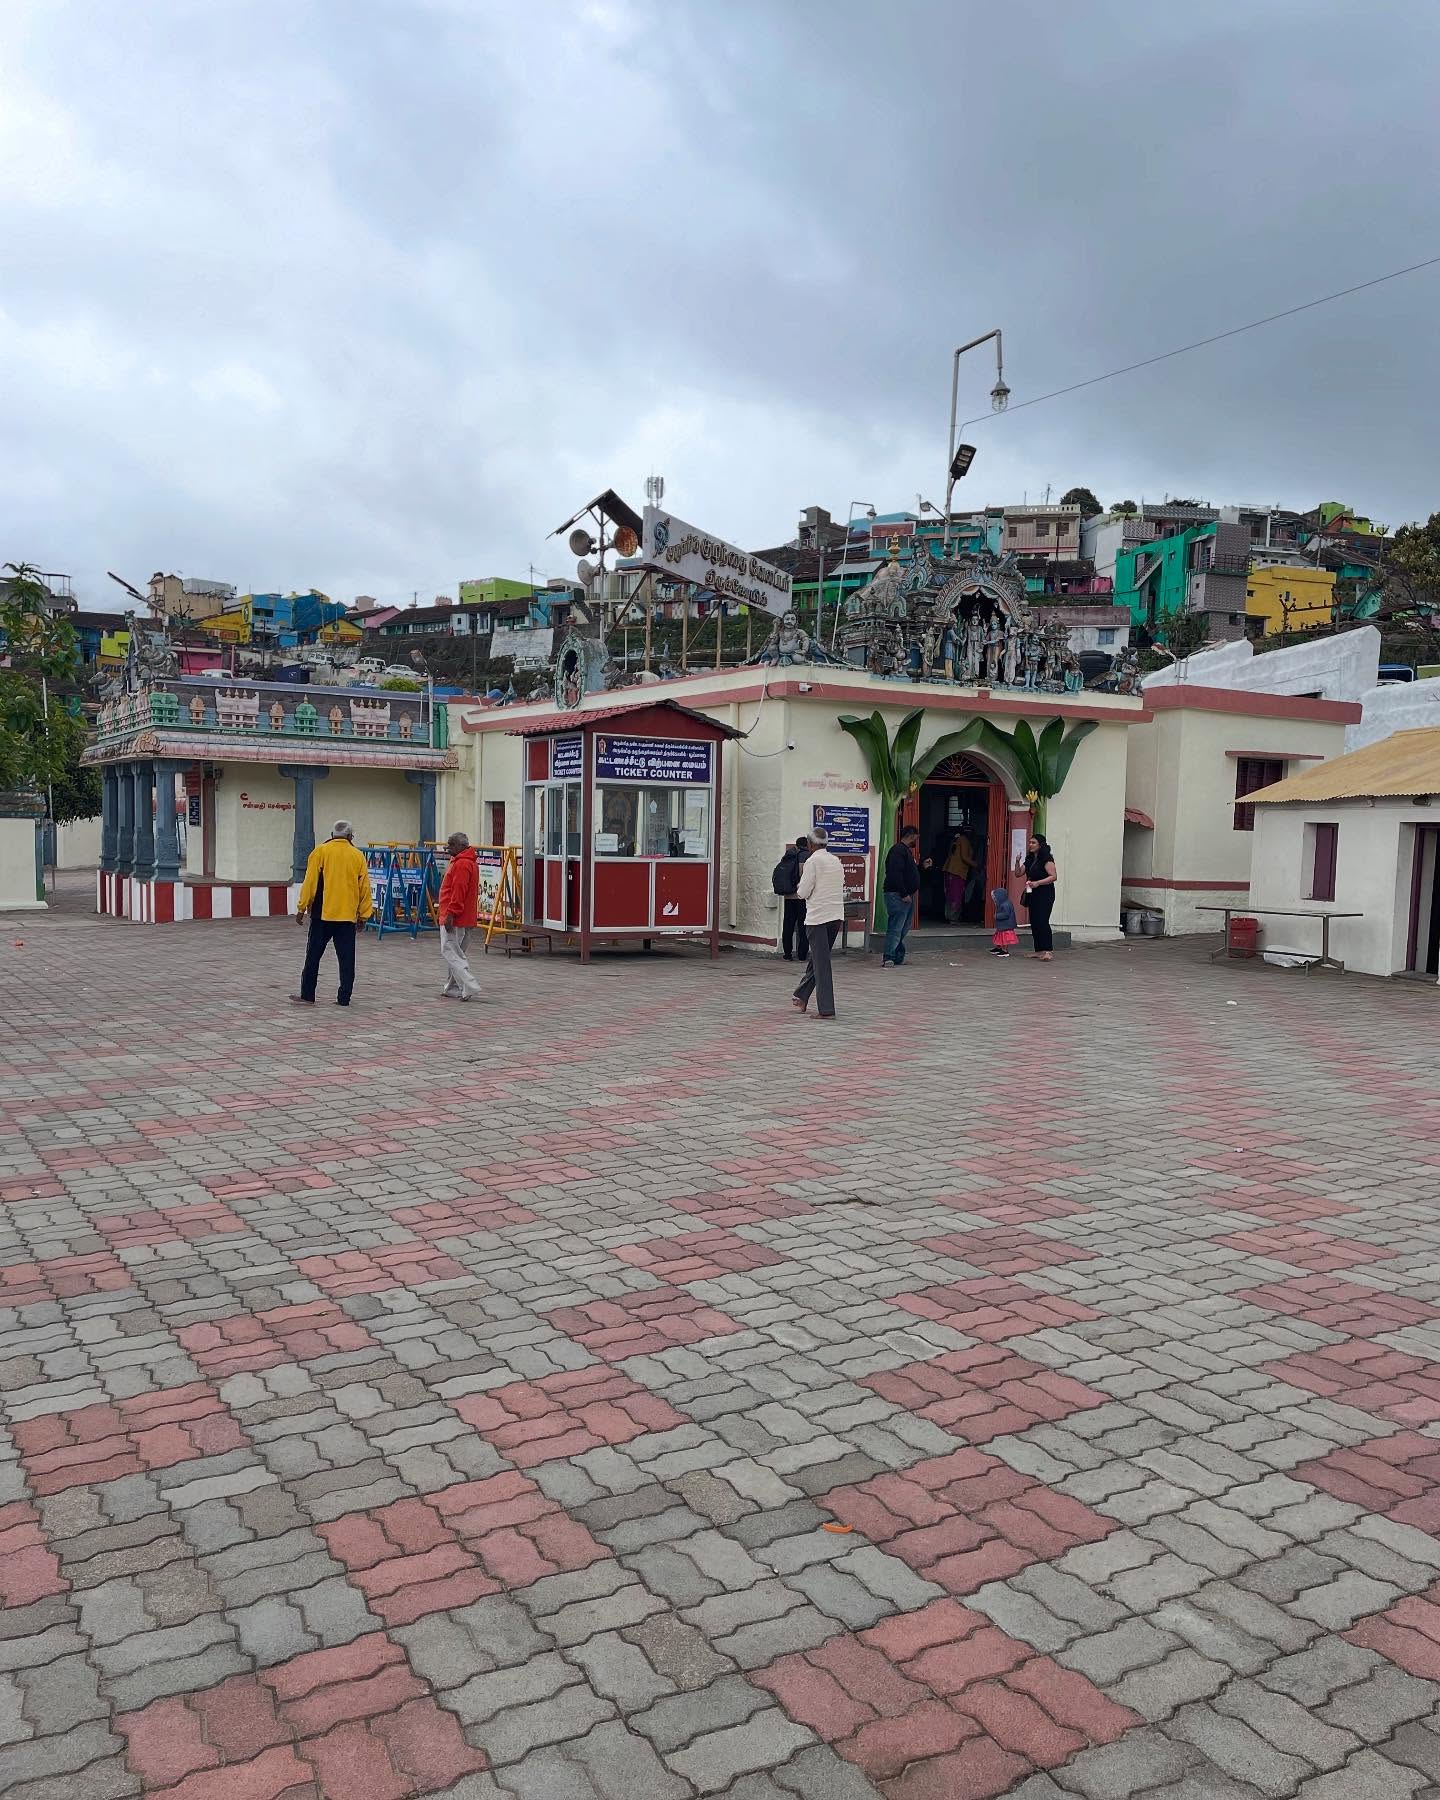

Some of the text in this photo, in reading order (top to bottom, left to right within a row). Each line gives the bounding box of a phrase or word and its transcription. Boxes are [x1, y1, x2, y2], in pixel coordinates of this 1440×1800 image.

[700, 538, 747, 576] குழந்தை
[749, 555, 789, 593] வேலப்பர்
[648, 758, 680, 769] விற்பனை
[682, 760, 707, 769] மையம்
[615, 767, 693, 779] TICKET COUNTER
